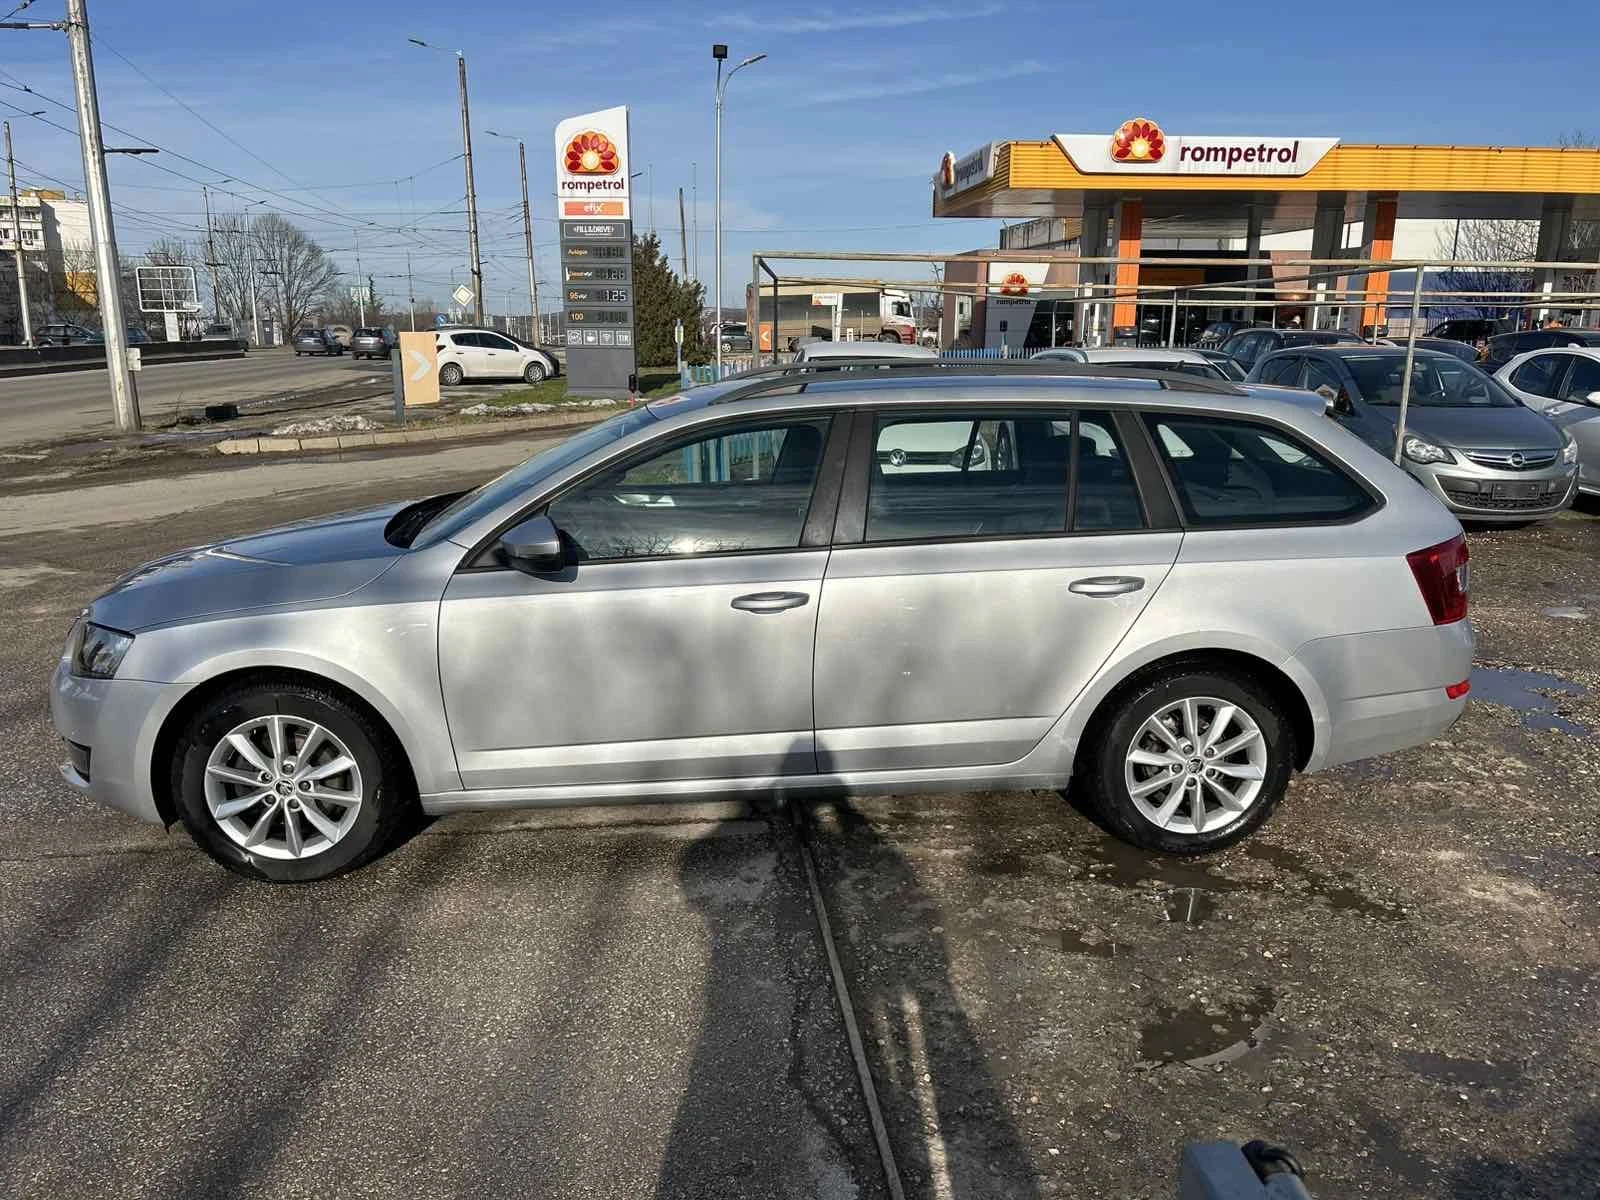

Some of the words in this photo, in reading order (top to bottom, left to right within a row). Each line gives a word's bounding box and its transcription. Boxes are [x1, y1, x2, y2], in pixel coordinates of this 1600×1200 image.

[1180, 140, 1299, 170] rompetrol
[561, 177, 625, 193] rompetrol
[571, 312, 584, 321] 100
